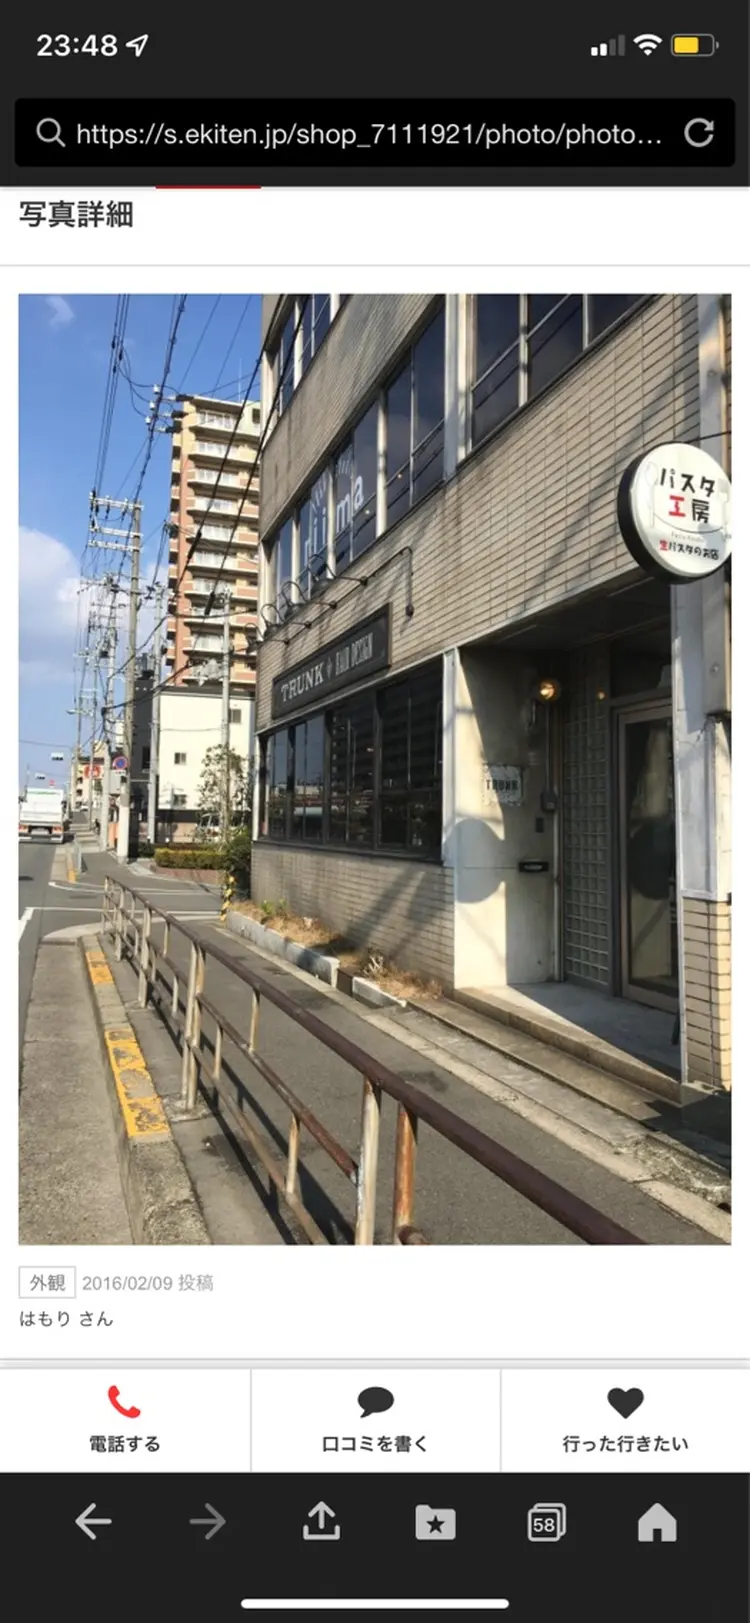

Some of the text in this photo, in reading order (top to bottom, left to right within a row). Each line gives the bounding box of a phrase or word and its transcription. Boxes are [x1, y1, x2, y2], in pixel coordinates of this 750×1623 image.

[36, 33, 118, 57] 23:48
[18, 200, 134, 229] 写真詳細
[660, 467, 716, 498] パスタ
[668, 494, 710, 524] 工房
[659, 539, 719, 561] 生パスタのお店
[281, 661, 324, 702] TRUNK
[486, 779, 519, 792] TRUNK
[29, 1273, 66, 1292] 外観
[82, 1274, 214, 1292] 2016/02/09 投稿
[19, 1310, 114, 1328] はもり さん
[89, 1434, 161, 1453] 電話する
[322, 1434, 427, 1453] 口コミを書く
[562, 1434, 689, 1453] 行った行きたい
[533, 1517, 556, 1533] 58
